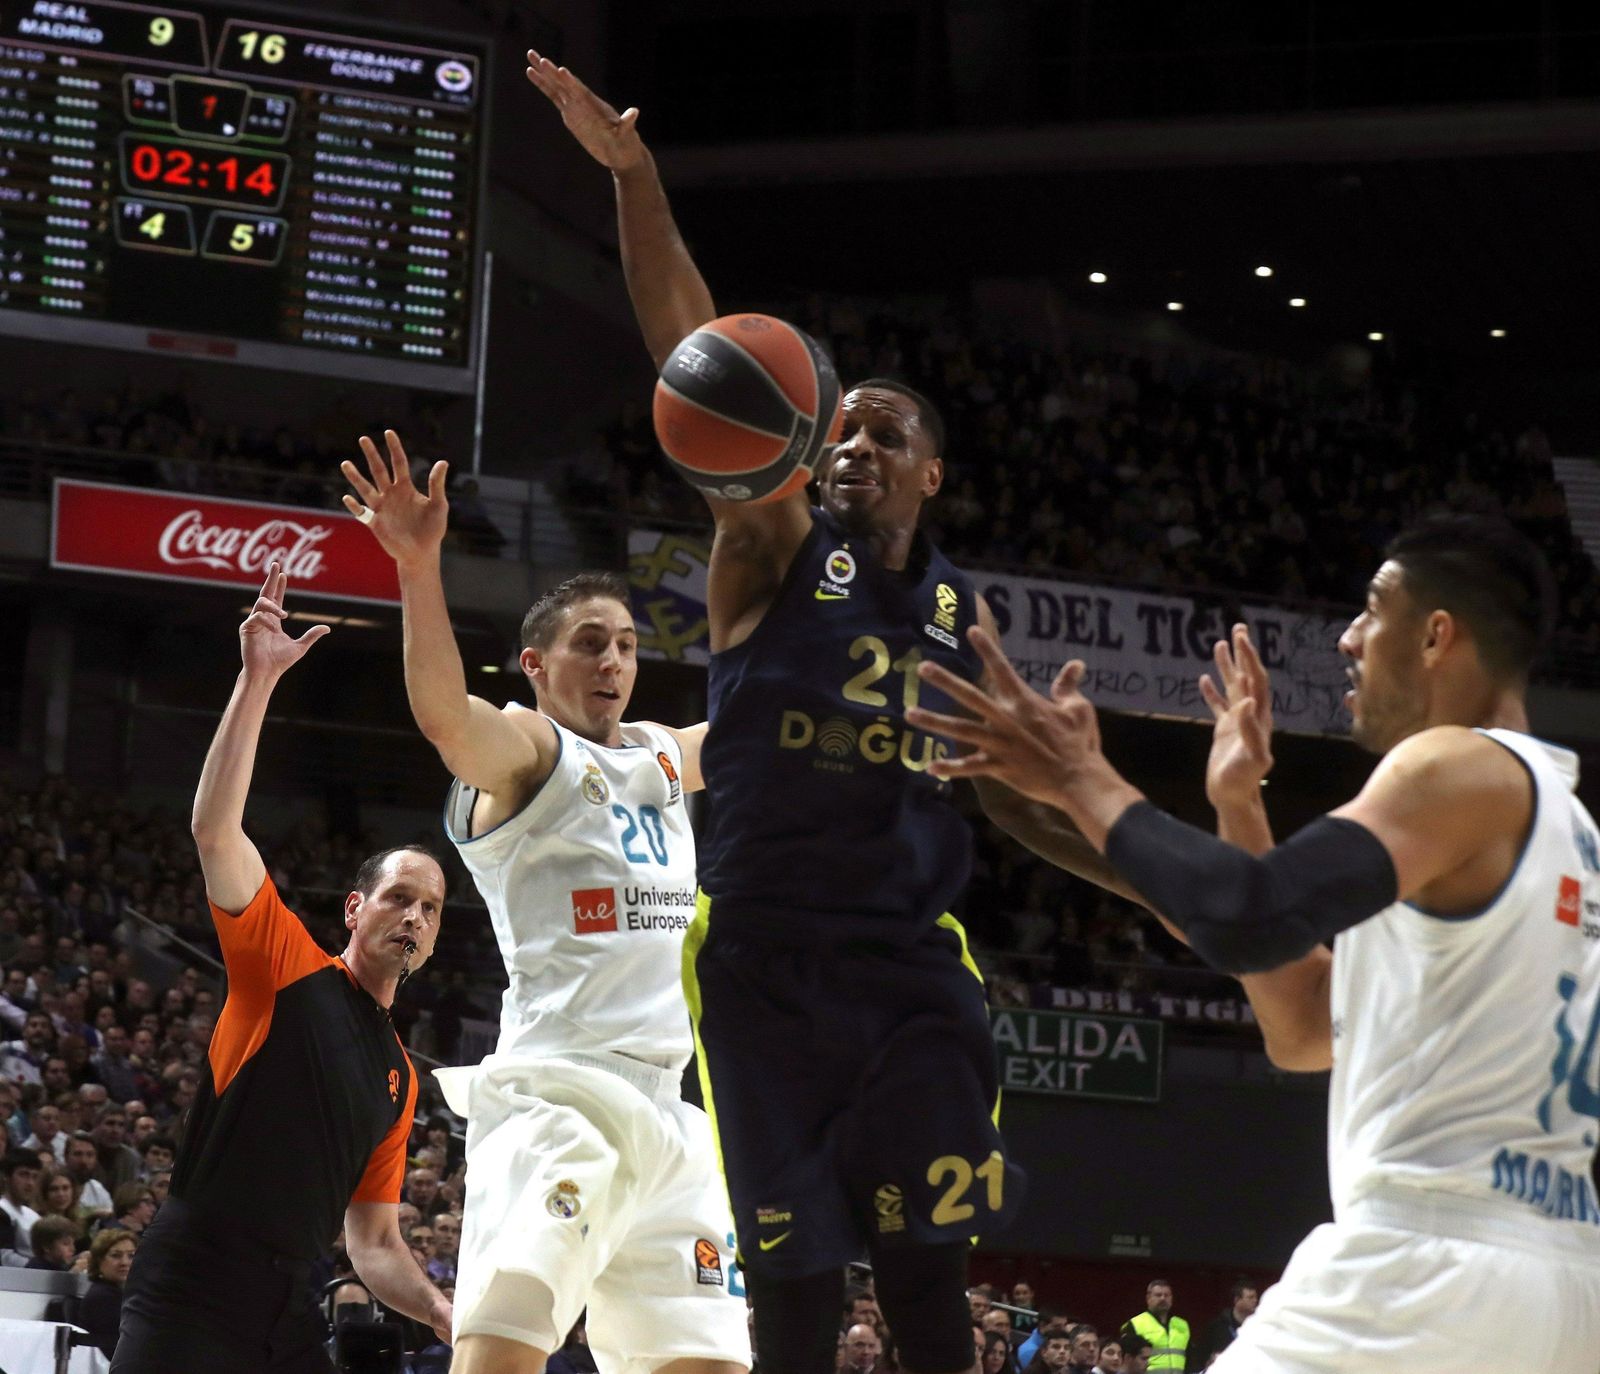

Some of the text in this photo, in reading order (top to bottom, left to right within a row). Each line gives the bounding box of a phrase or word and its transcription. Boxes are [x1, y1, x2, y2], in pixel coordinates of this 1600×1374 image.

[33, 0, 90, 22] REAL
[18, 18, 104, 44] MADRID
[148, 17, 174, 46] 9
[238, 31, 287, 65] 16
[203, 95, 218, 119] 1
[132, 145, 277, 197] 02:14
[138, 212, 166, 240] 4
[229, 223, 255, 252] 5
[1026, 588, 1124, 651] DEL
[1137, 603, 1286, 669] TIGE
[842, 635, 922, 709] 21
[612, 803, 668, 867] 20
[627, 912, 689, 933] Europea
[992, 1012, 1148, 1063] ALIDA
[1005, 1056, 1091, 1091] EXIT
[927, 1150, 1004, 1226] 21
